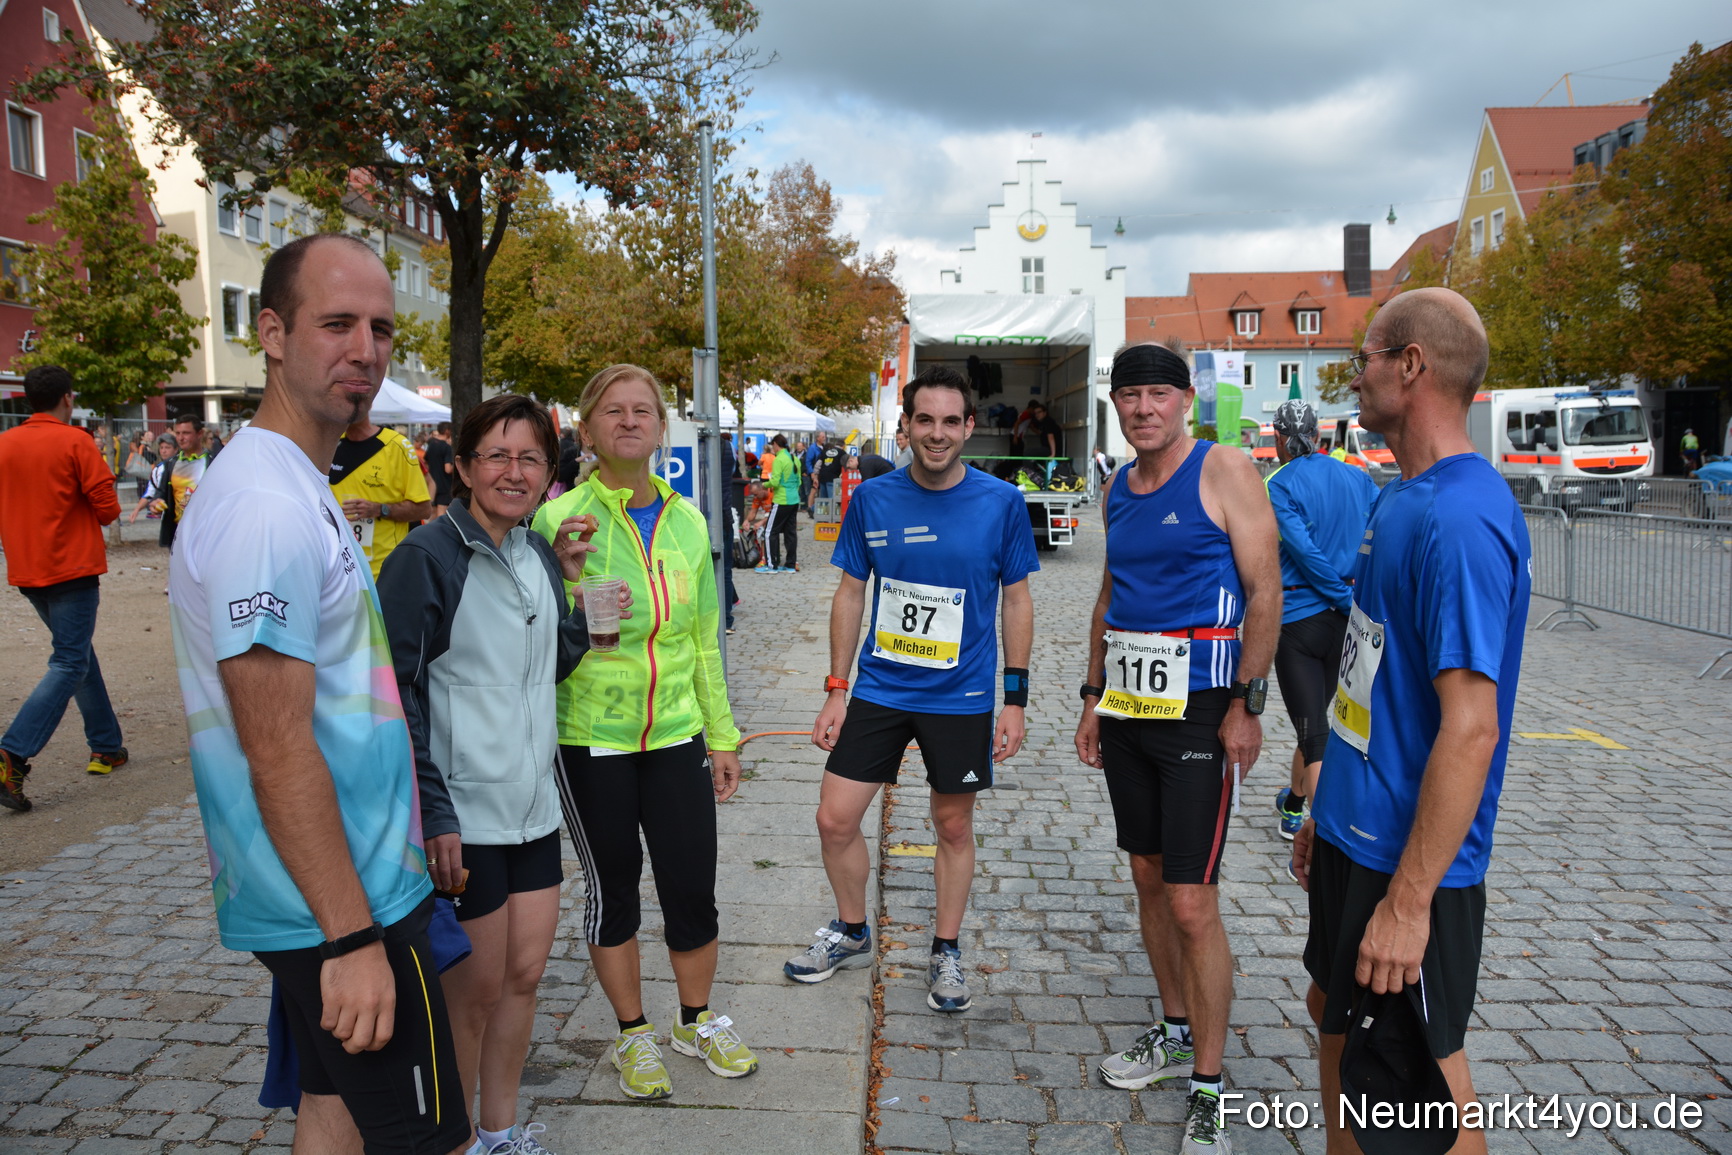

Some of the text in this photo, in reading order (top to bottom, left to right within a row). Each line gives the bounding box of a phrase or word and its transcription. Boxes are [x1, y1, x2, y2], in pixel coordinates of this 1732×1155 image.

[419, 387, 441, 397] NKD
[664, 456, 686, 488] P
[882, 586, 950, 604] PARTL Neumarkt
[229, 591, 290, 622] BOCK
[901, 603, 937, 635] 87
[893, 638, 937, 656] Michael
[1128, 643, 1171, 655] Neumarkt
[1340, 632, 1358, 689] 82
[1118, 655, 1168, 693] 116
[1105, 695, 1178, 716] Hans-Werner
[1192, 752, 1213, 760] asics
